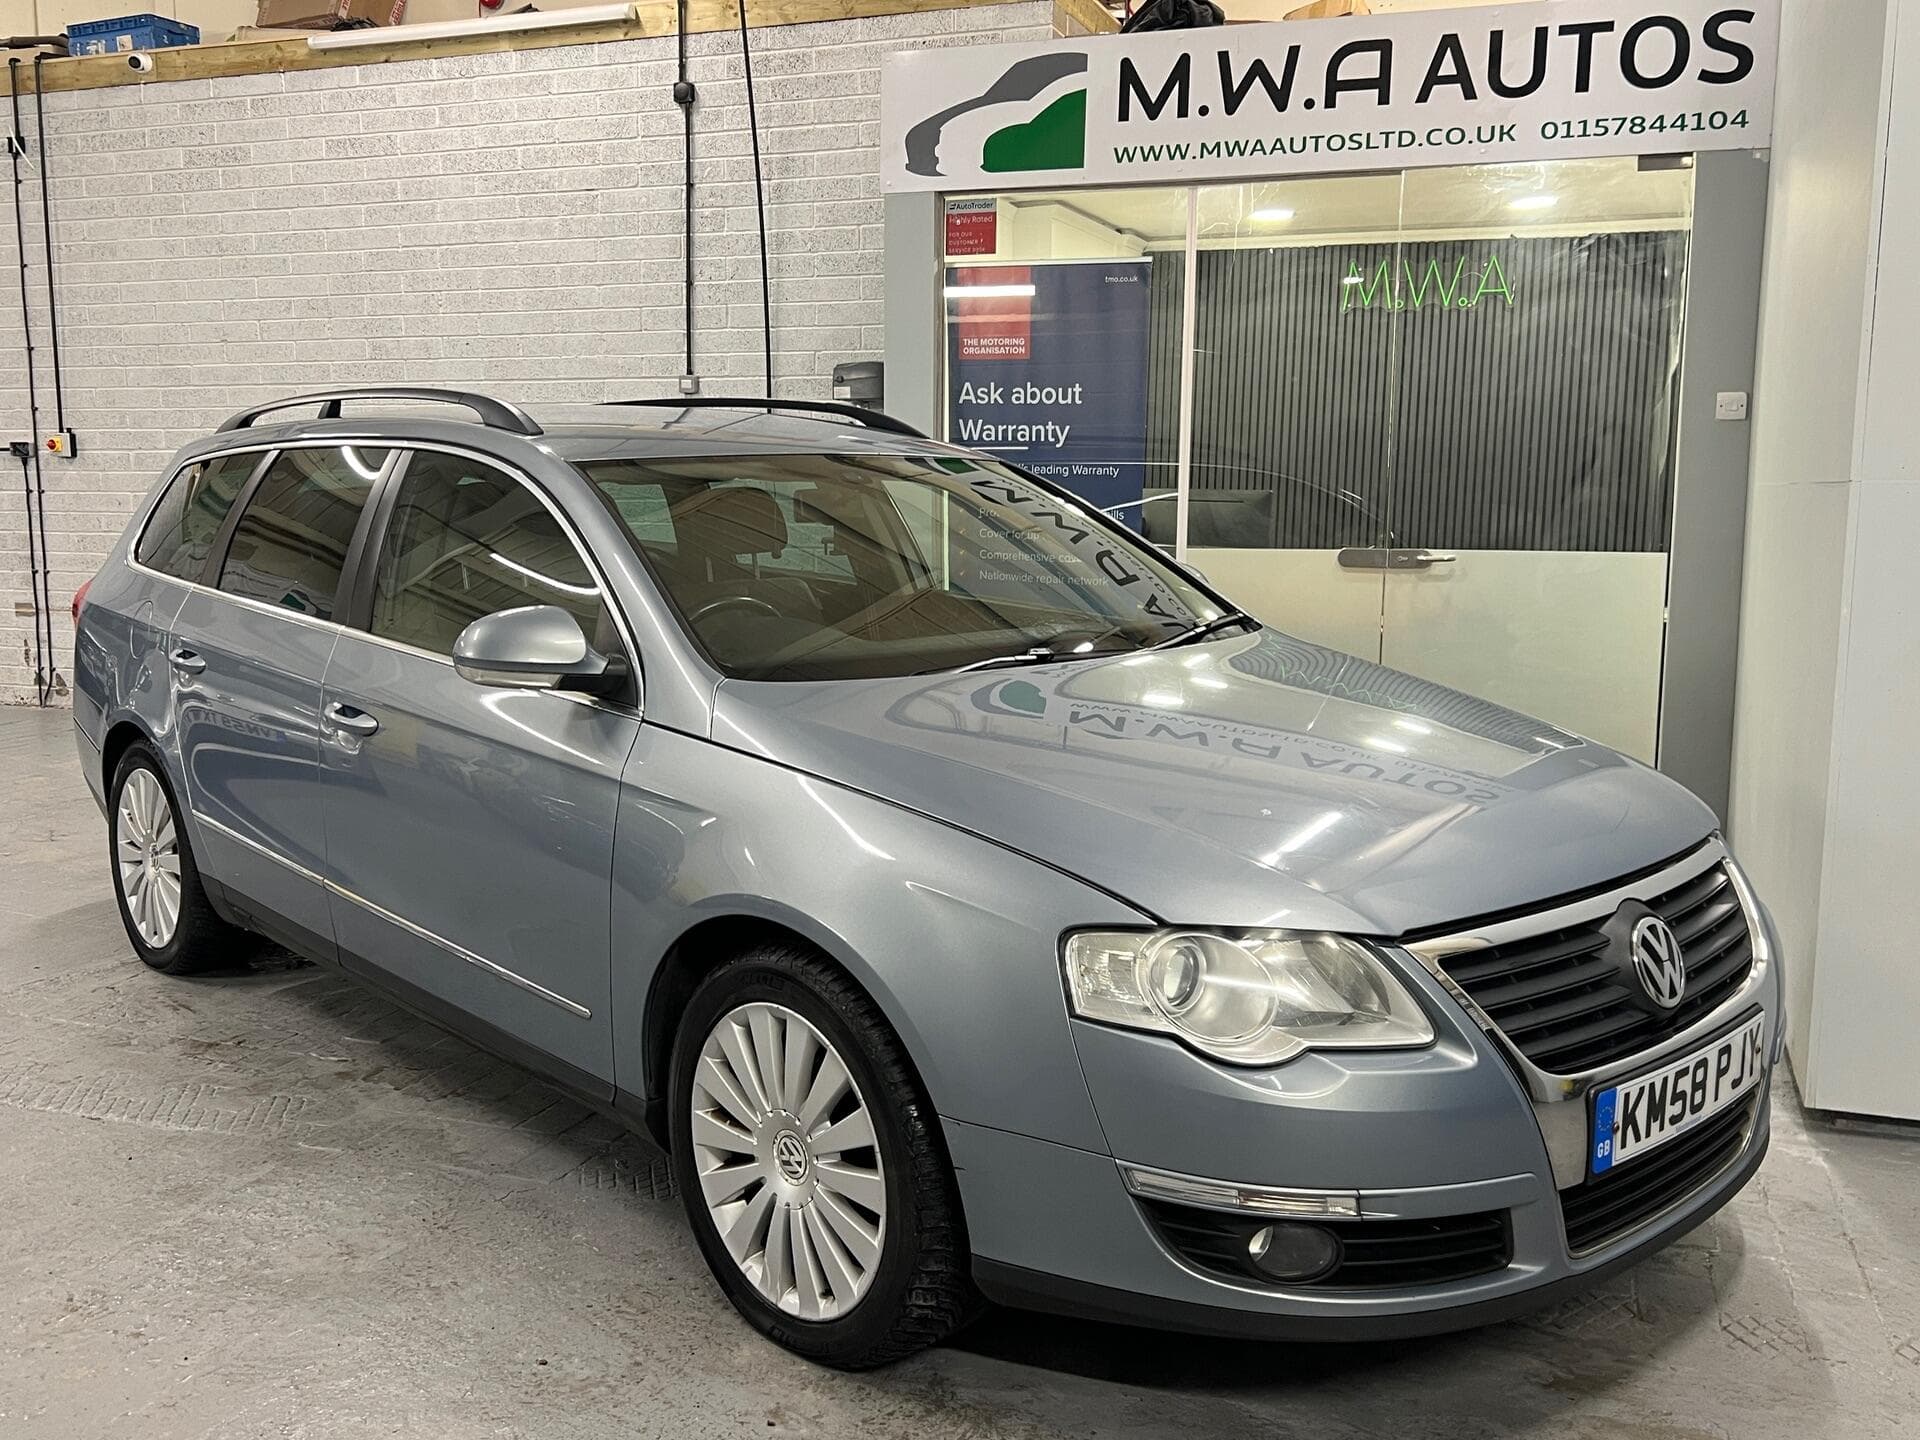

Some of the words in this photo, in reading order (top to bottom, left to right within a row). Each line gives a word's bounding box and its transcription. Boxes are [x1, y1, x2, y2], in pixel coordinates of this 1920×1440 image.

[1117, 39, 1392, 122] M.W.A
[1416, 9, 1756, 103] AUTOS
[1113, 123, 1516, 163] WWW.MWAAUTOSLTD.CO.UK
[1540, 110, 1749, 140] 01157844104
[956, 202, 993, 210] AutoTrader
[972, 215, 993, 223] Rated
[1104, 275, 1138, 283] tmo.co.uk
[963, 338, 979, 346] THE
[980, 338, 1025, 346] MOTORING
[963, 346, 1025, 355] ORGANISATION
[958, 382, 1004, 404] Ask
[1011, 382, 1083, 405] about
[959, 419, 1070, 447] Warranty
[1032, 464, 1069, 476] leading
[1072, 464, 1120, 478] Warranty
[979, 528, 1008, 538] Cover
[979, 550, 1055, 563] Comprehensive
[979, 571, 1034, 582] Nationwide
[1036, 575, 1065, 586] repair
[1068, 575, 1109, 587] network
[1620, 1057, 1708, 1150] KM58
[1714, 1022, 1762, 1102] PJY
[1597, 1139, 1611, 1159] GB
